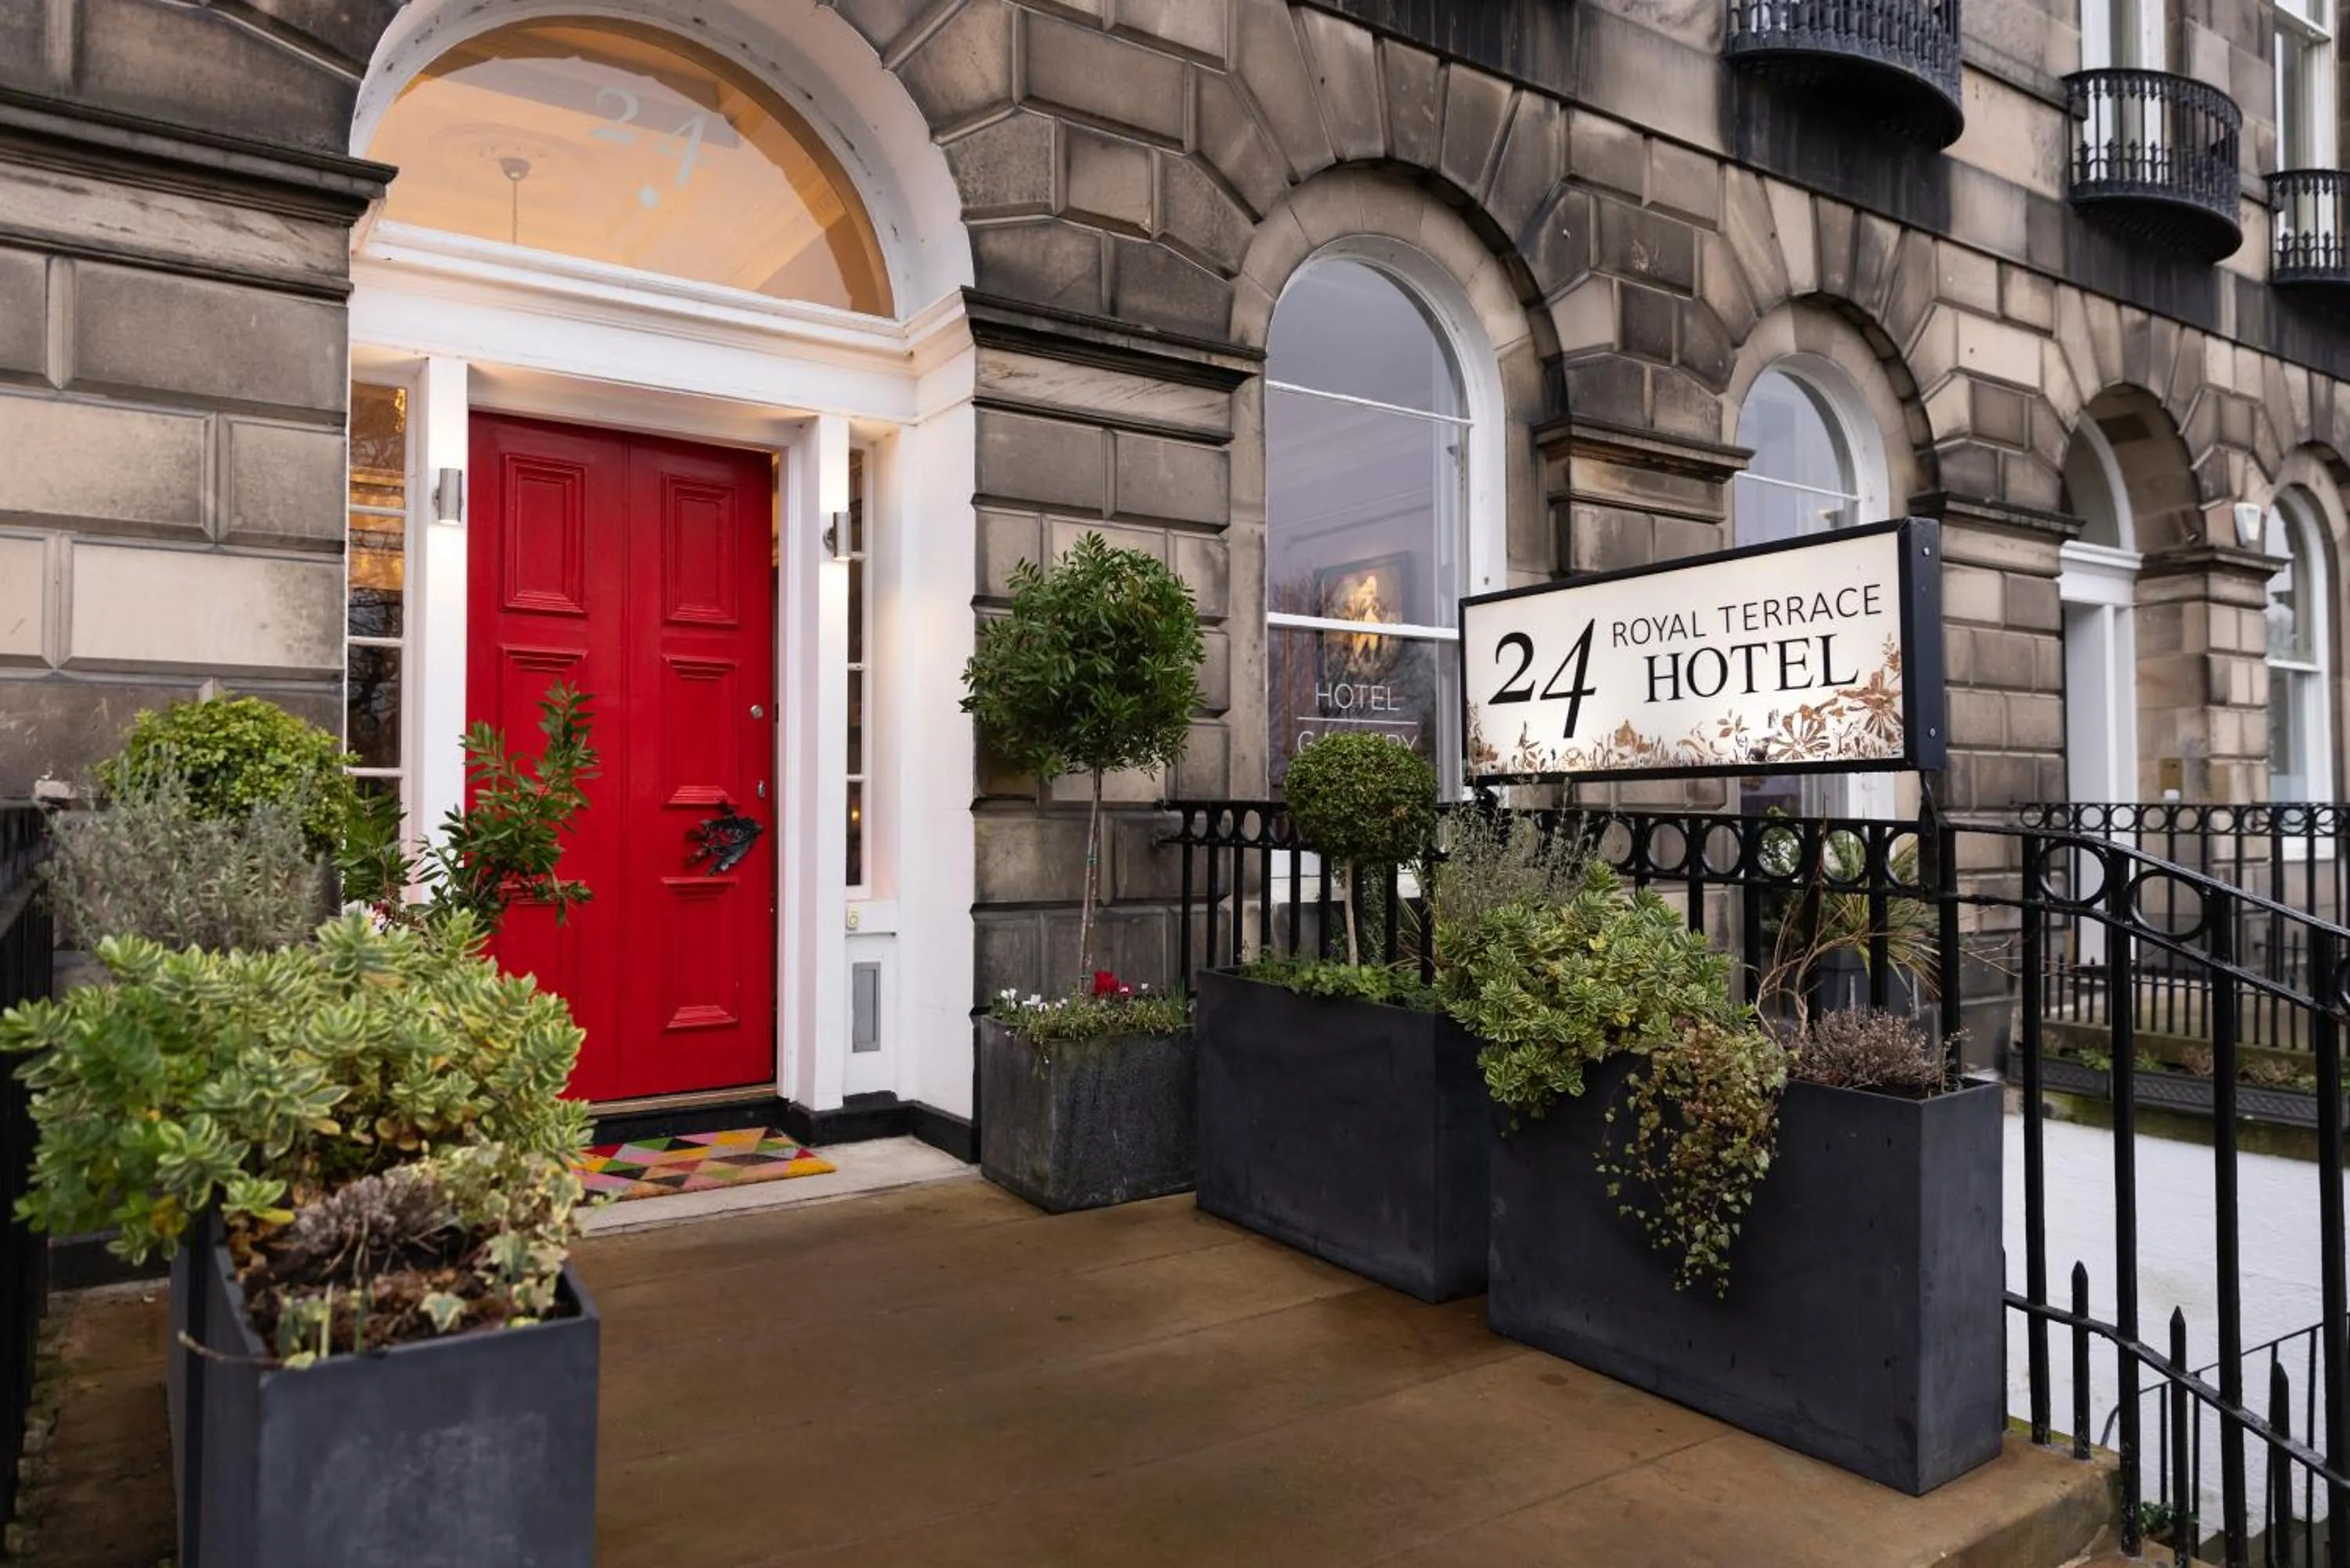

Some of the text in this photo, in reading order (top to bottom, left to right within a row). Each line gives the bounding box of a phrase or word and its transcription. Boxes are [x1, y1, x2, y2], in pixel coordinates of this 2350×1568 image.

[591, 85, 713, 189] 24
[1612, 583, 1882, 649] ROYAL TERRACE
[1314, 682, 1401, 712] HOTEL
[1488, 618, 1596, 739] 24
[1643, 634, 1859, 703] HOTEL
